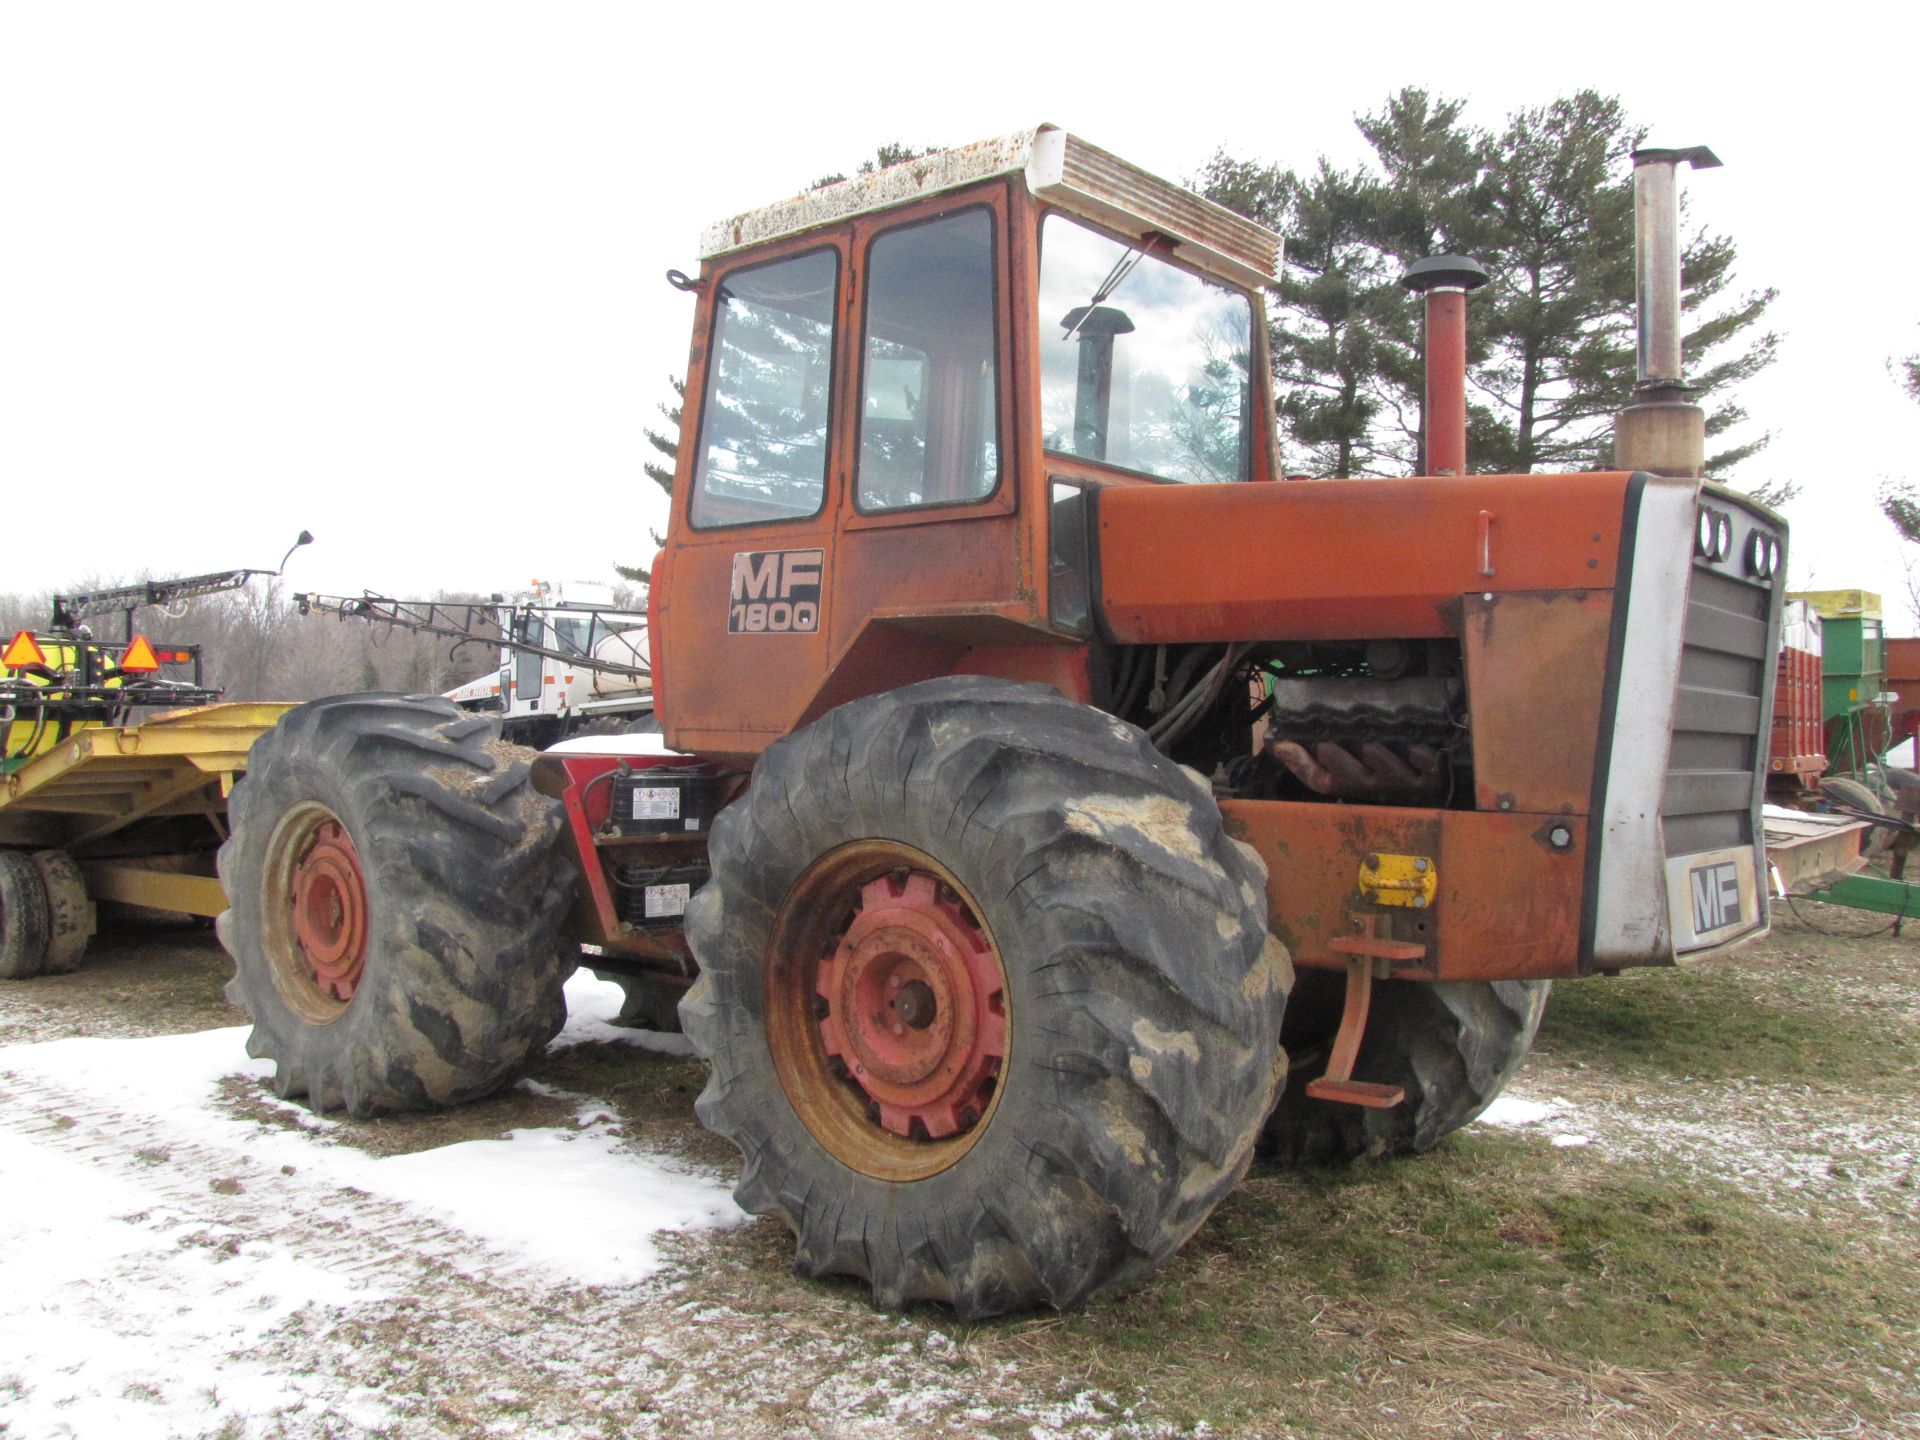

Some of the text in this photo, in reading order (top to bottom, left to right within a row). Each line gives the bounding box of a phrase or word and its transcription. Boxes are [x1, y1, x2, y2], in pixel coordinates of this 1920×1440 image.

[733, 551, 822, 600] MF
[731, 601, 817, 631] 1800
[1690, 864, 1738, 932] MF
